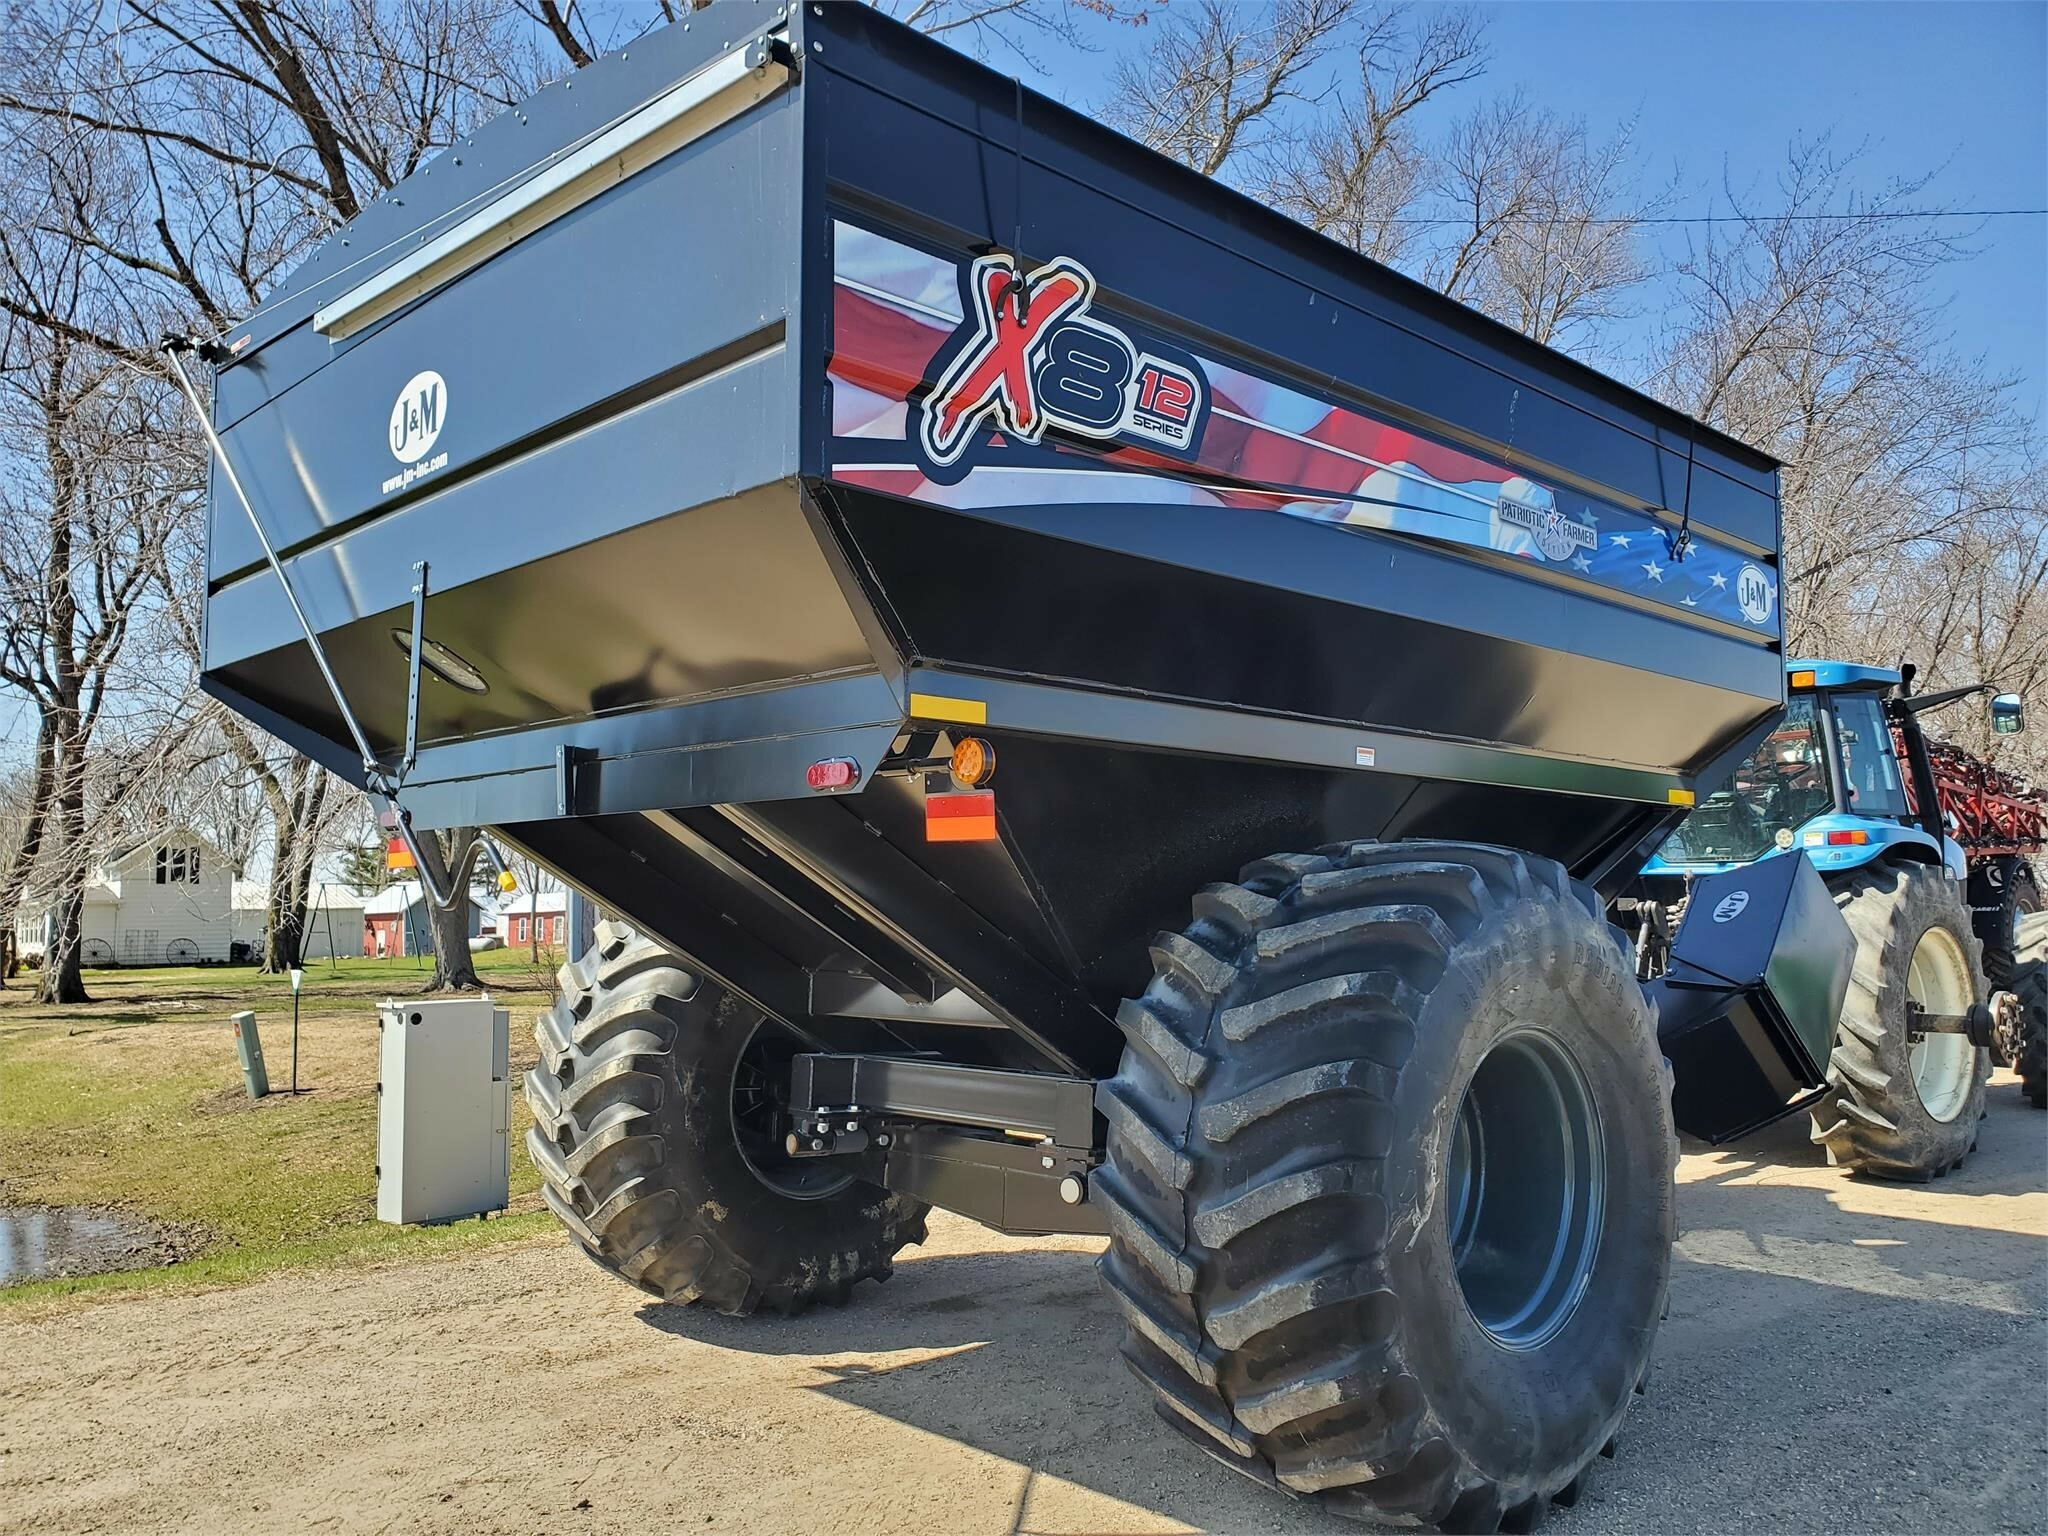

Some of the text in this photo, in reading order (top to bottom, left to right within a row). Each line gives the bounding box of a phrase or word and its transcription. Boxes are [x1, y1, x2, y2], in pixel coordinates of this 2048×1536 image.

[1140, 368, 1193, 422] 12
[393, 382, 440, 453] J&M
[1133, 413, 1184, 440] SERIES
[382, 451, 448, 494] www.jm-inc.com
[1501, 500, 1596, 546] PATRIOTIC FARMER
[1740, 576, 1767, 613] J&M
